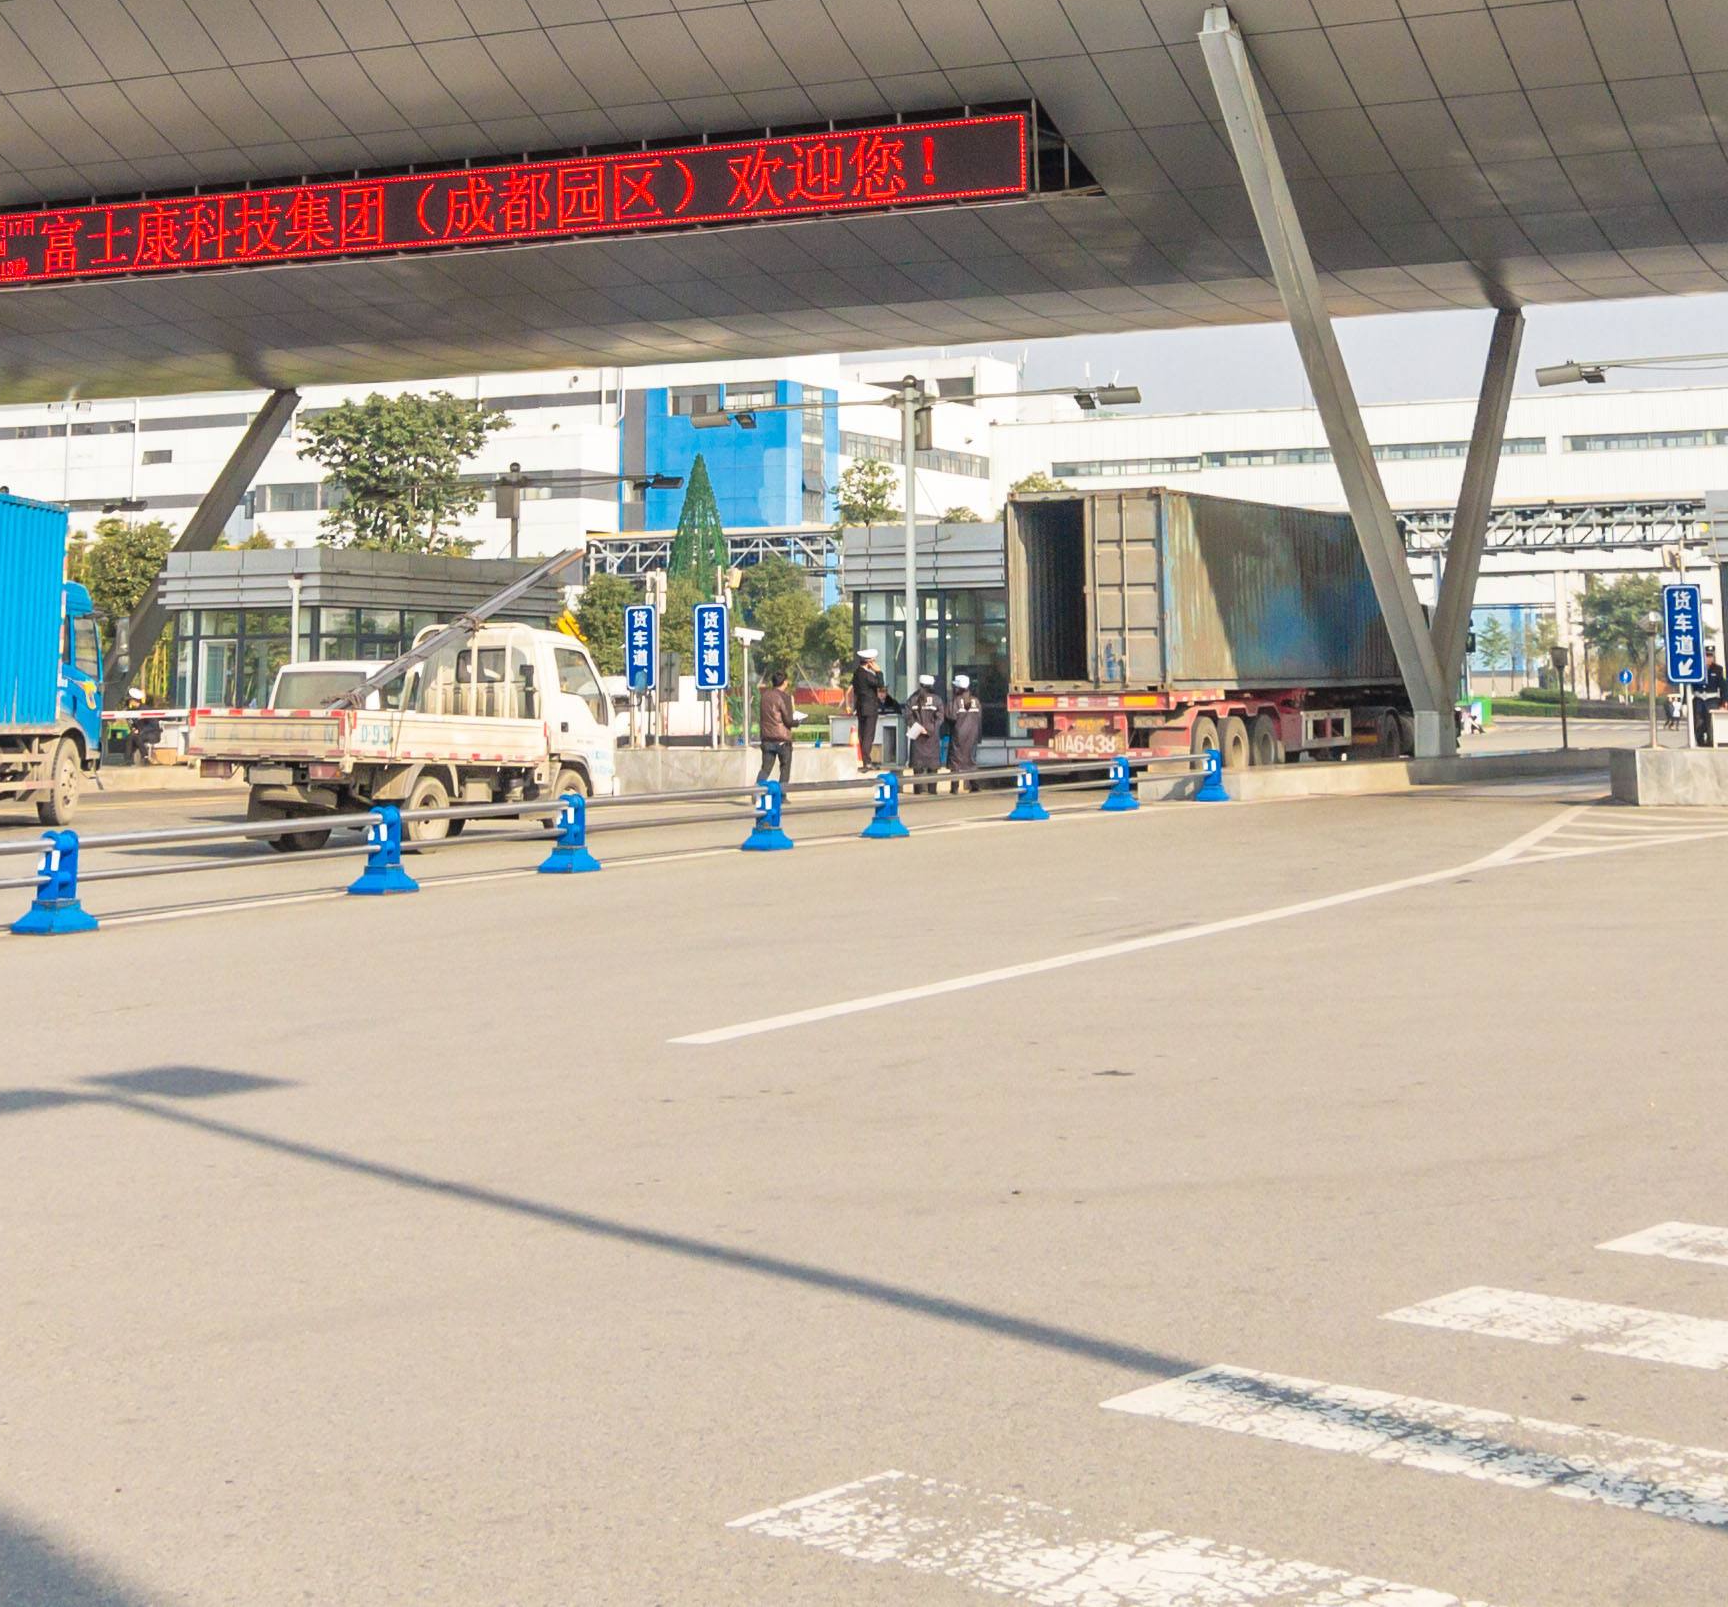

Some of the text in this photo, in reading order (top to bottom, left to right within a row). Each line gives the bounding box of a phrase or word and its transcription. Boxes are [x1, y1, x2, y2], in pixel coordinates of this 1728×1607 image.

[633, 610, 649, 666] 货车道
[703, 611, 720, 666] 货车道
[1673, 591, 1695, 655] 货车道
